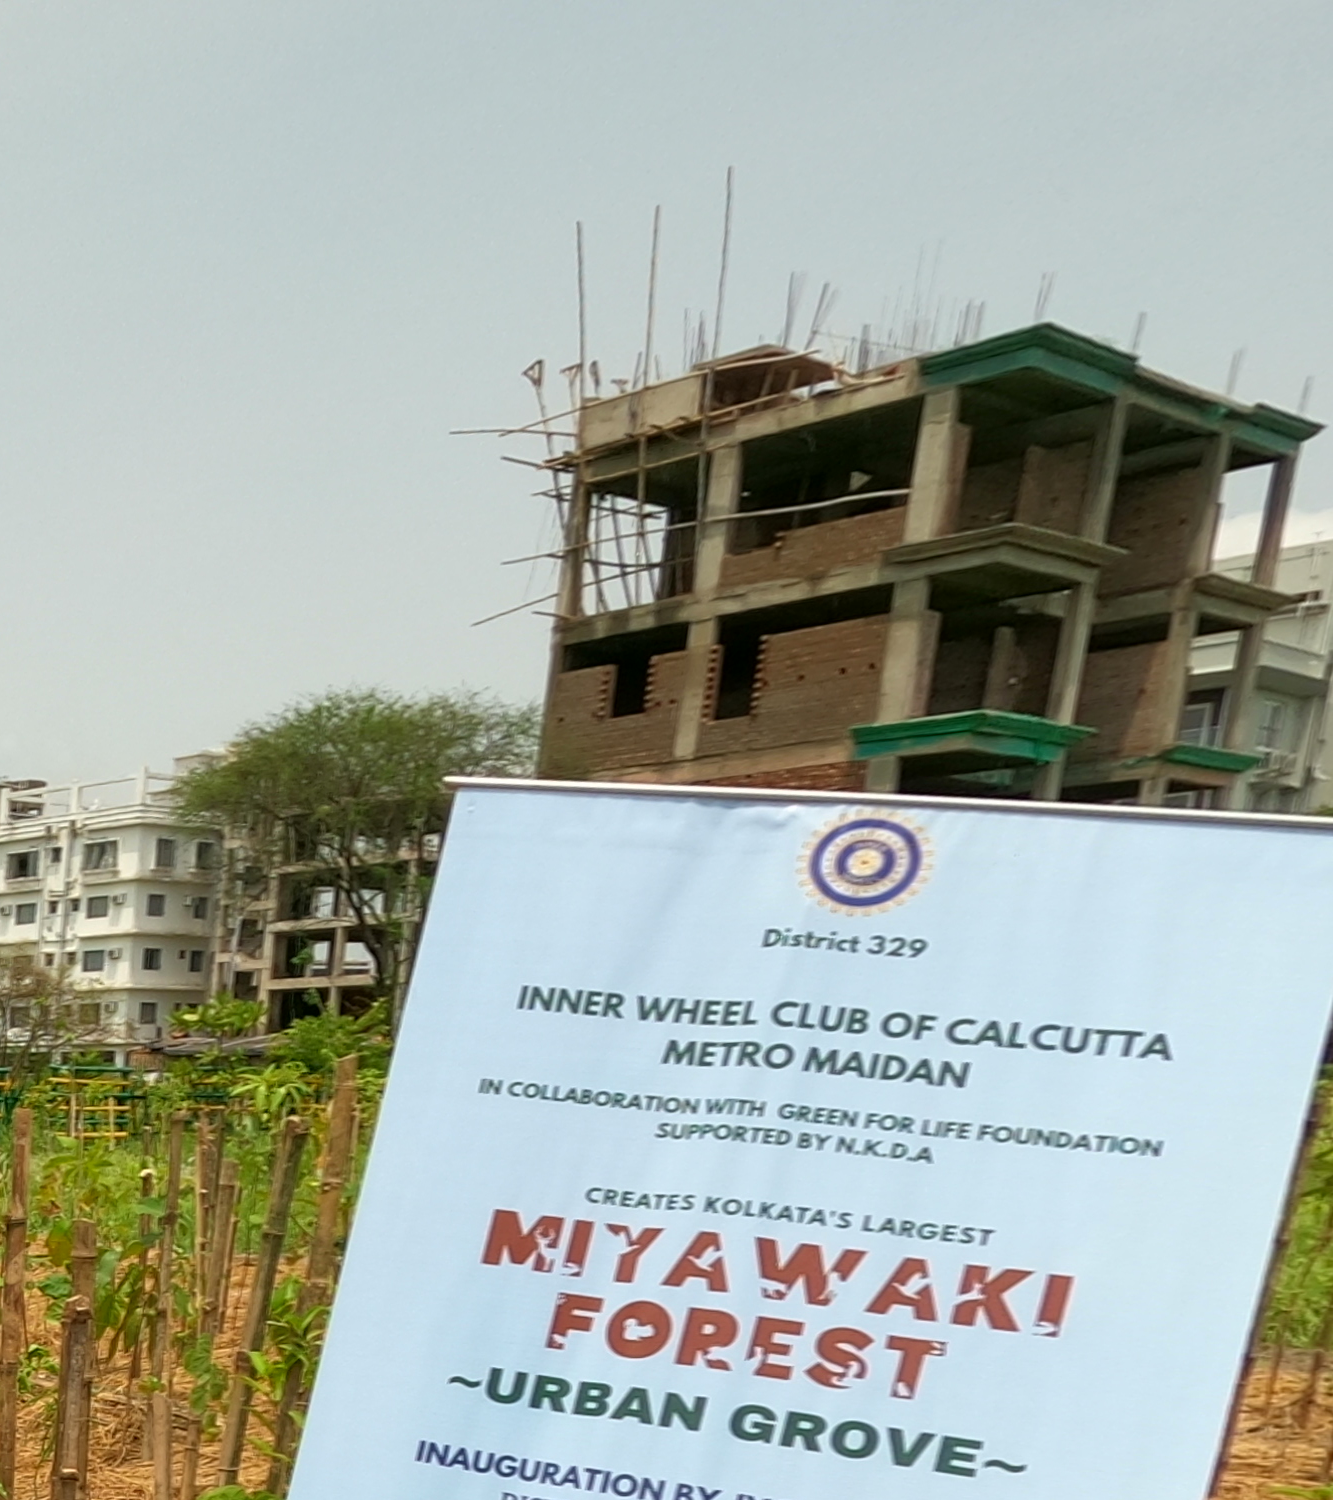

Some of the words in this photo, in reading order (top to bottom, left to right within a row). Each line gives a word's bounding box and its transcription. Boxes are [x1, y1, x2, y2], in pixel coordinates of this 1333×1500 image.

[762, 928, 860, 953] District
[866, 935, 928, 958] 329
[517, 985, 625, 1019] INNER
[637, 996, 758, 1026] WHEEL
[770, 1001, 869, 1034] CLUB
[880, 1012, 938, 1040] OF
[945, 1019, 1173, 1061] CALCUTTA
[661, 1040, 795, 1069] METRO
[802, 1047, 970, 1088] MAIDAN
[478, 1079, 503, 1095] IN
[507, 1082, 700, 1114] COLLABORATION
[706, 1099, 766, 1117] WITH
[777, 1104, 859, 1127] GREEN
[863, 1113, 915, 1134] FOR
[920, 1120, 972, 1139] LIFE
[977, 1125, 1164, 1157] FOUNDATION
[655, 1123, 792, 1145] SUPPORTED
[796, 1132, 832, 1150] BY
[835, 1137, 933, 1164] N.K.D.A
[585, 1188, 696, 1210] CREATES
[703, 1197, 853, 1229] KOLKATA'S
[861, 1215, 996, 1246] LARGEST
[480, 1209, 1074, 1338] MIYAWAKI
[545, 1292, 948, 1400] FOREST
[447, 1367, 708, 1431] ~URBAN
[728, 1404, 1027, 1477] GROVE~
